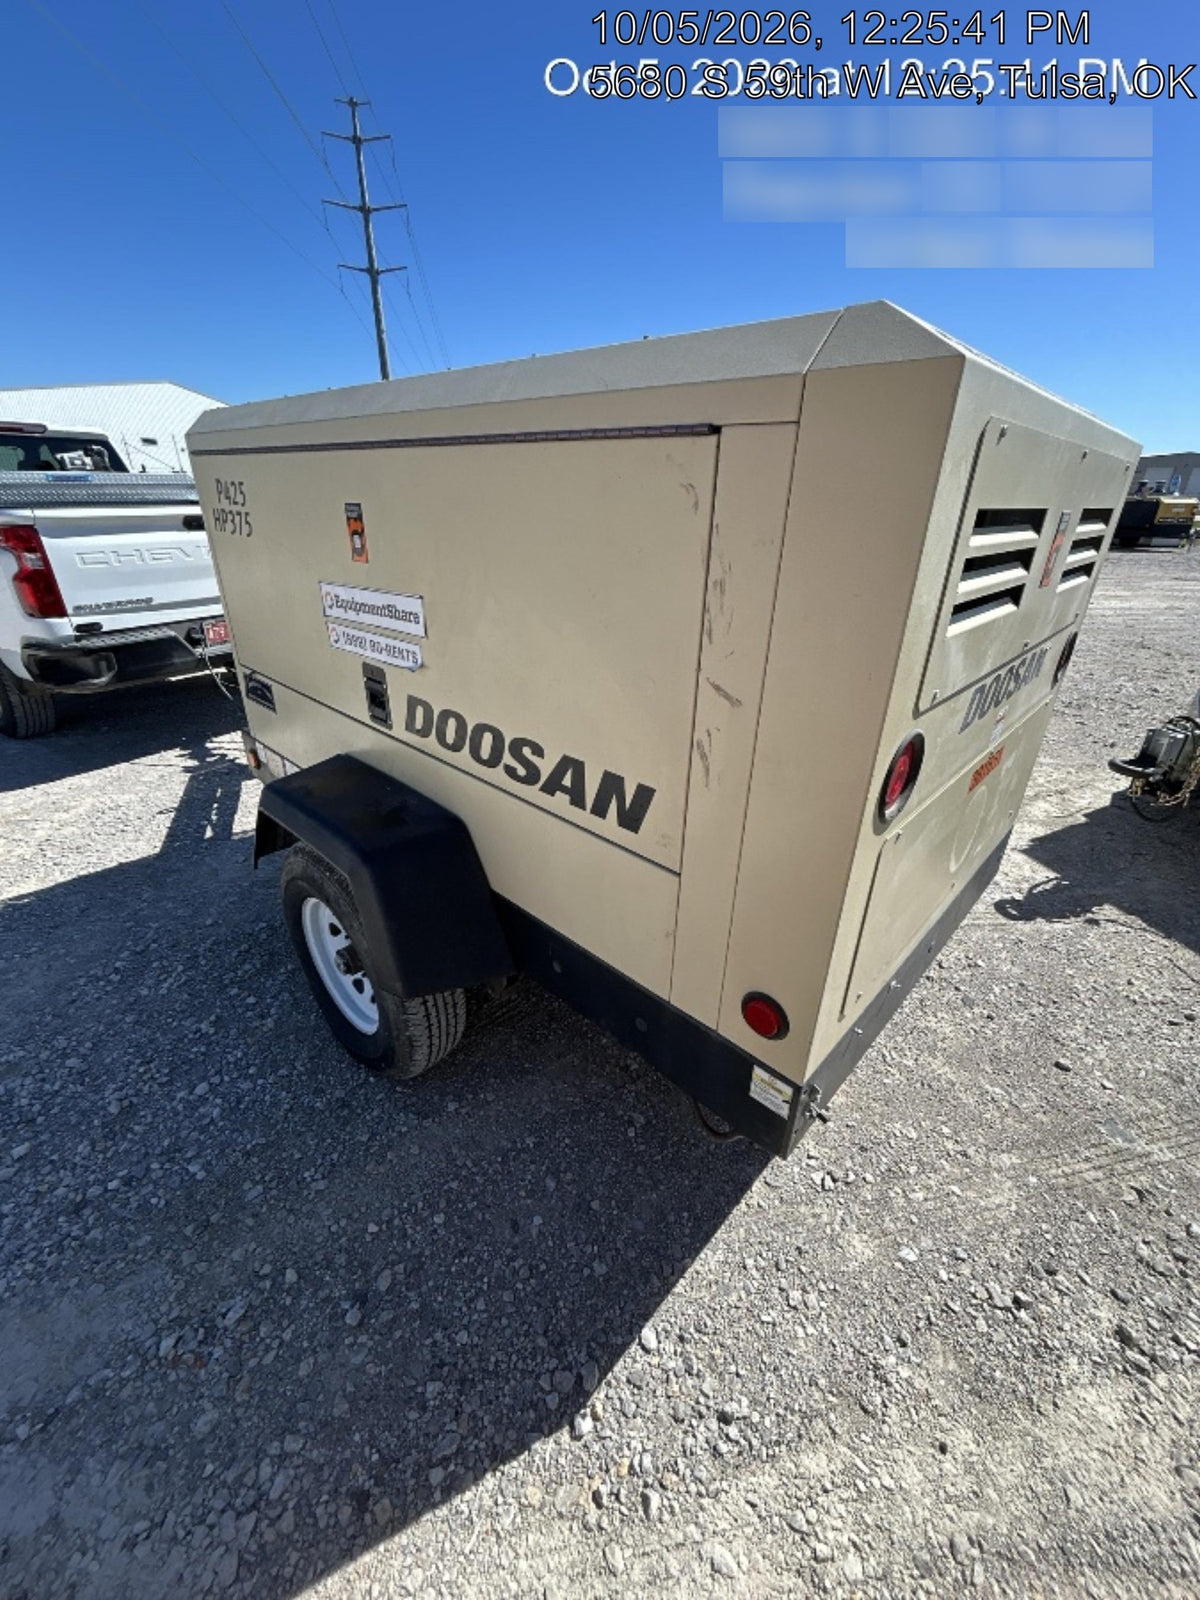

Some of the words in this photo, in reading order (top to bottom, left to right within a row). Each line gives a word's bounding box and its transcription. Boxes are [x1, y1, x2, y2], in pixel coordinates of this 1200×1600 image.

[215, 478, 246, 507] P425
[334, 593, 420, 624] EquipmentShare
[959, 647, 1048, 735] DOOSAN
[405, 694, 656, 834] DOOSAN
